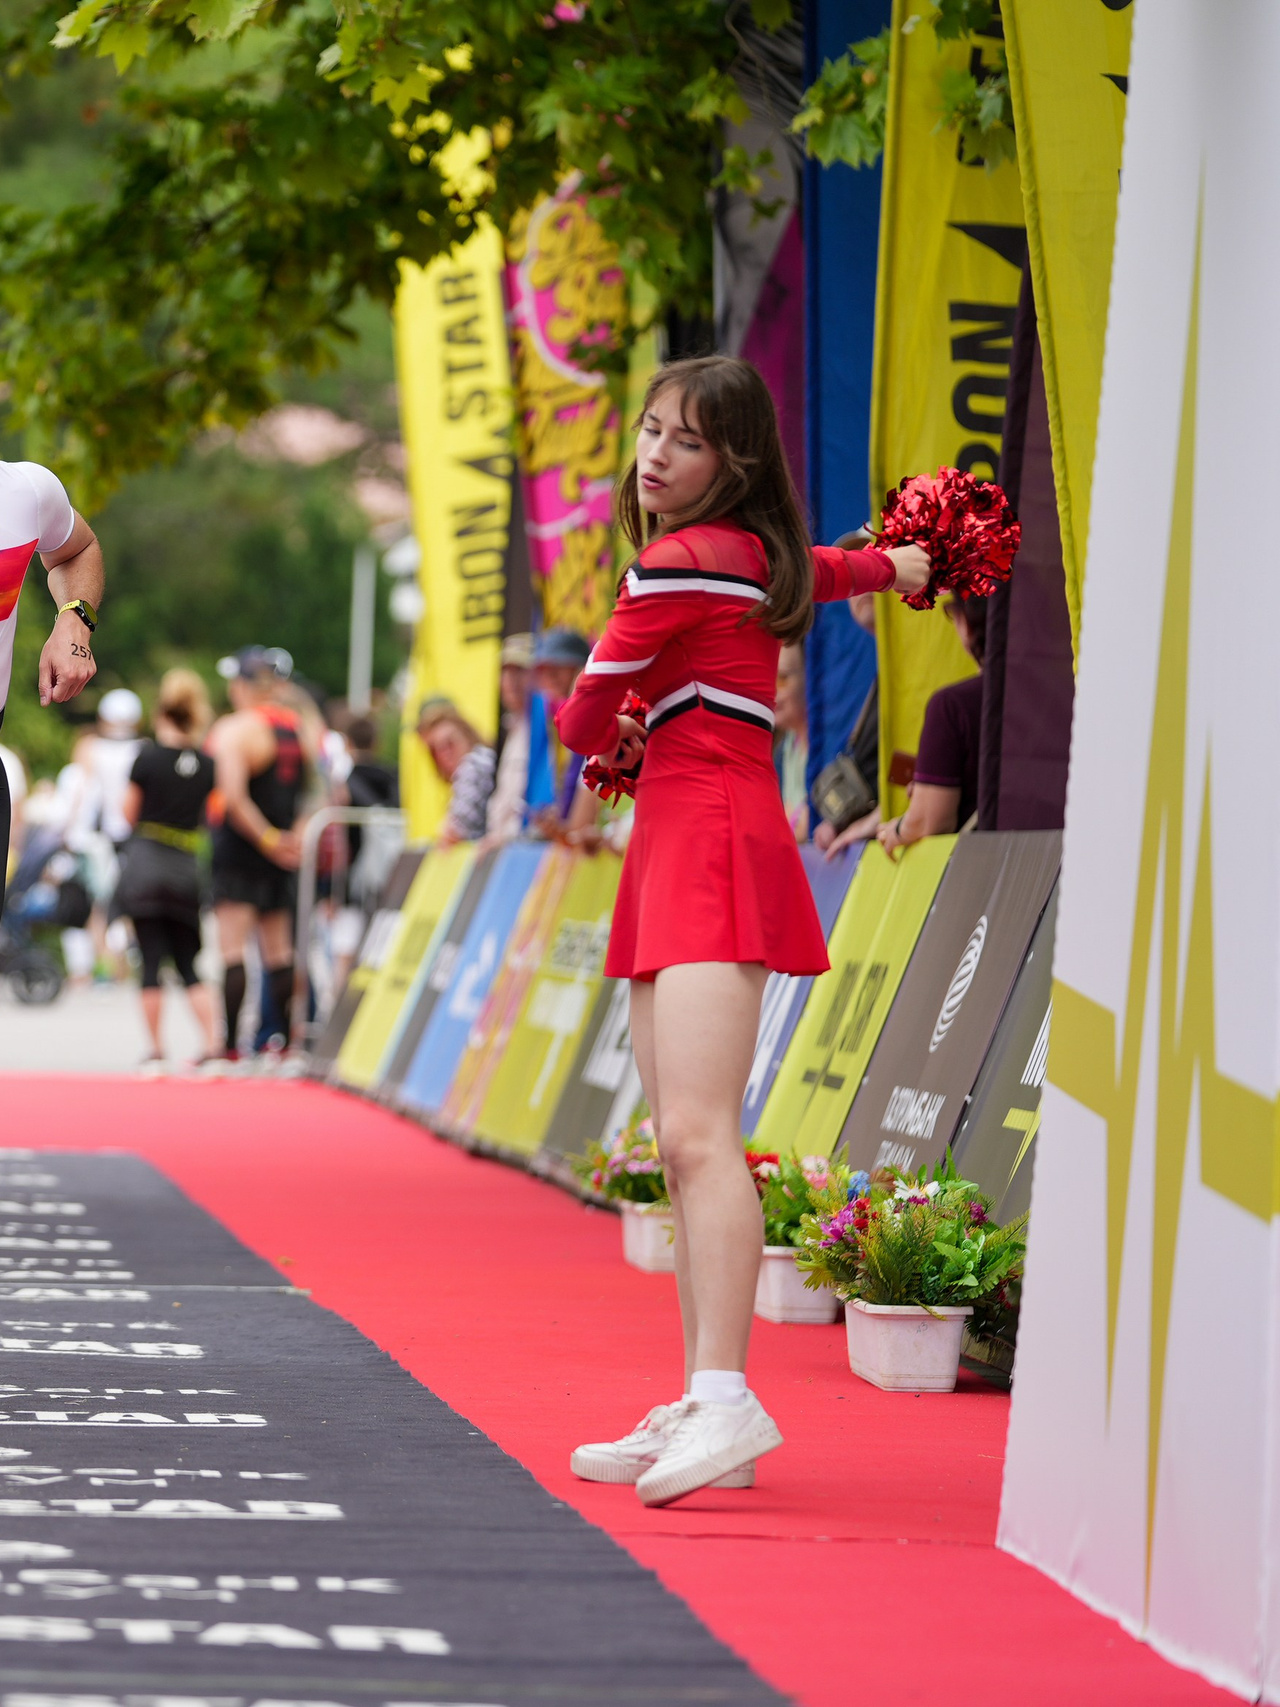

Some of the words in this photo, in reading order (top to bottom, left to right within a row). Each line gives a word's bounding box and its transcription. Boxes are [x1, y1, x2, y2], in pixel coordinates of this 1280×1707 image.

[437, 268, 487, 421] STAR
[454, 502, 506, 645] IRON
[71, 643, 92, 660] 257
